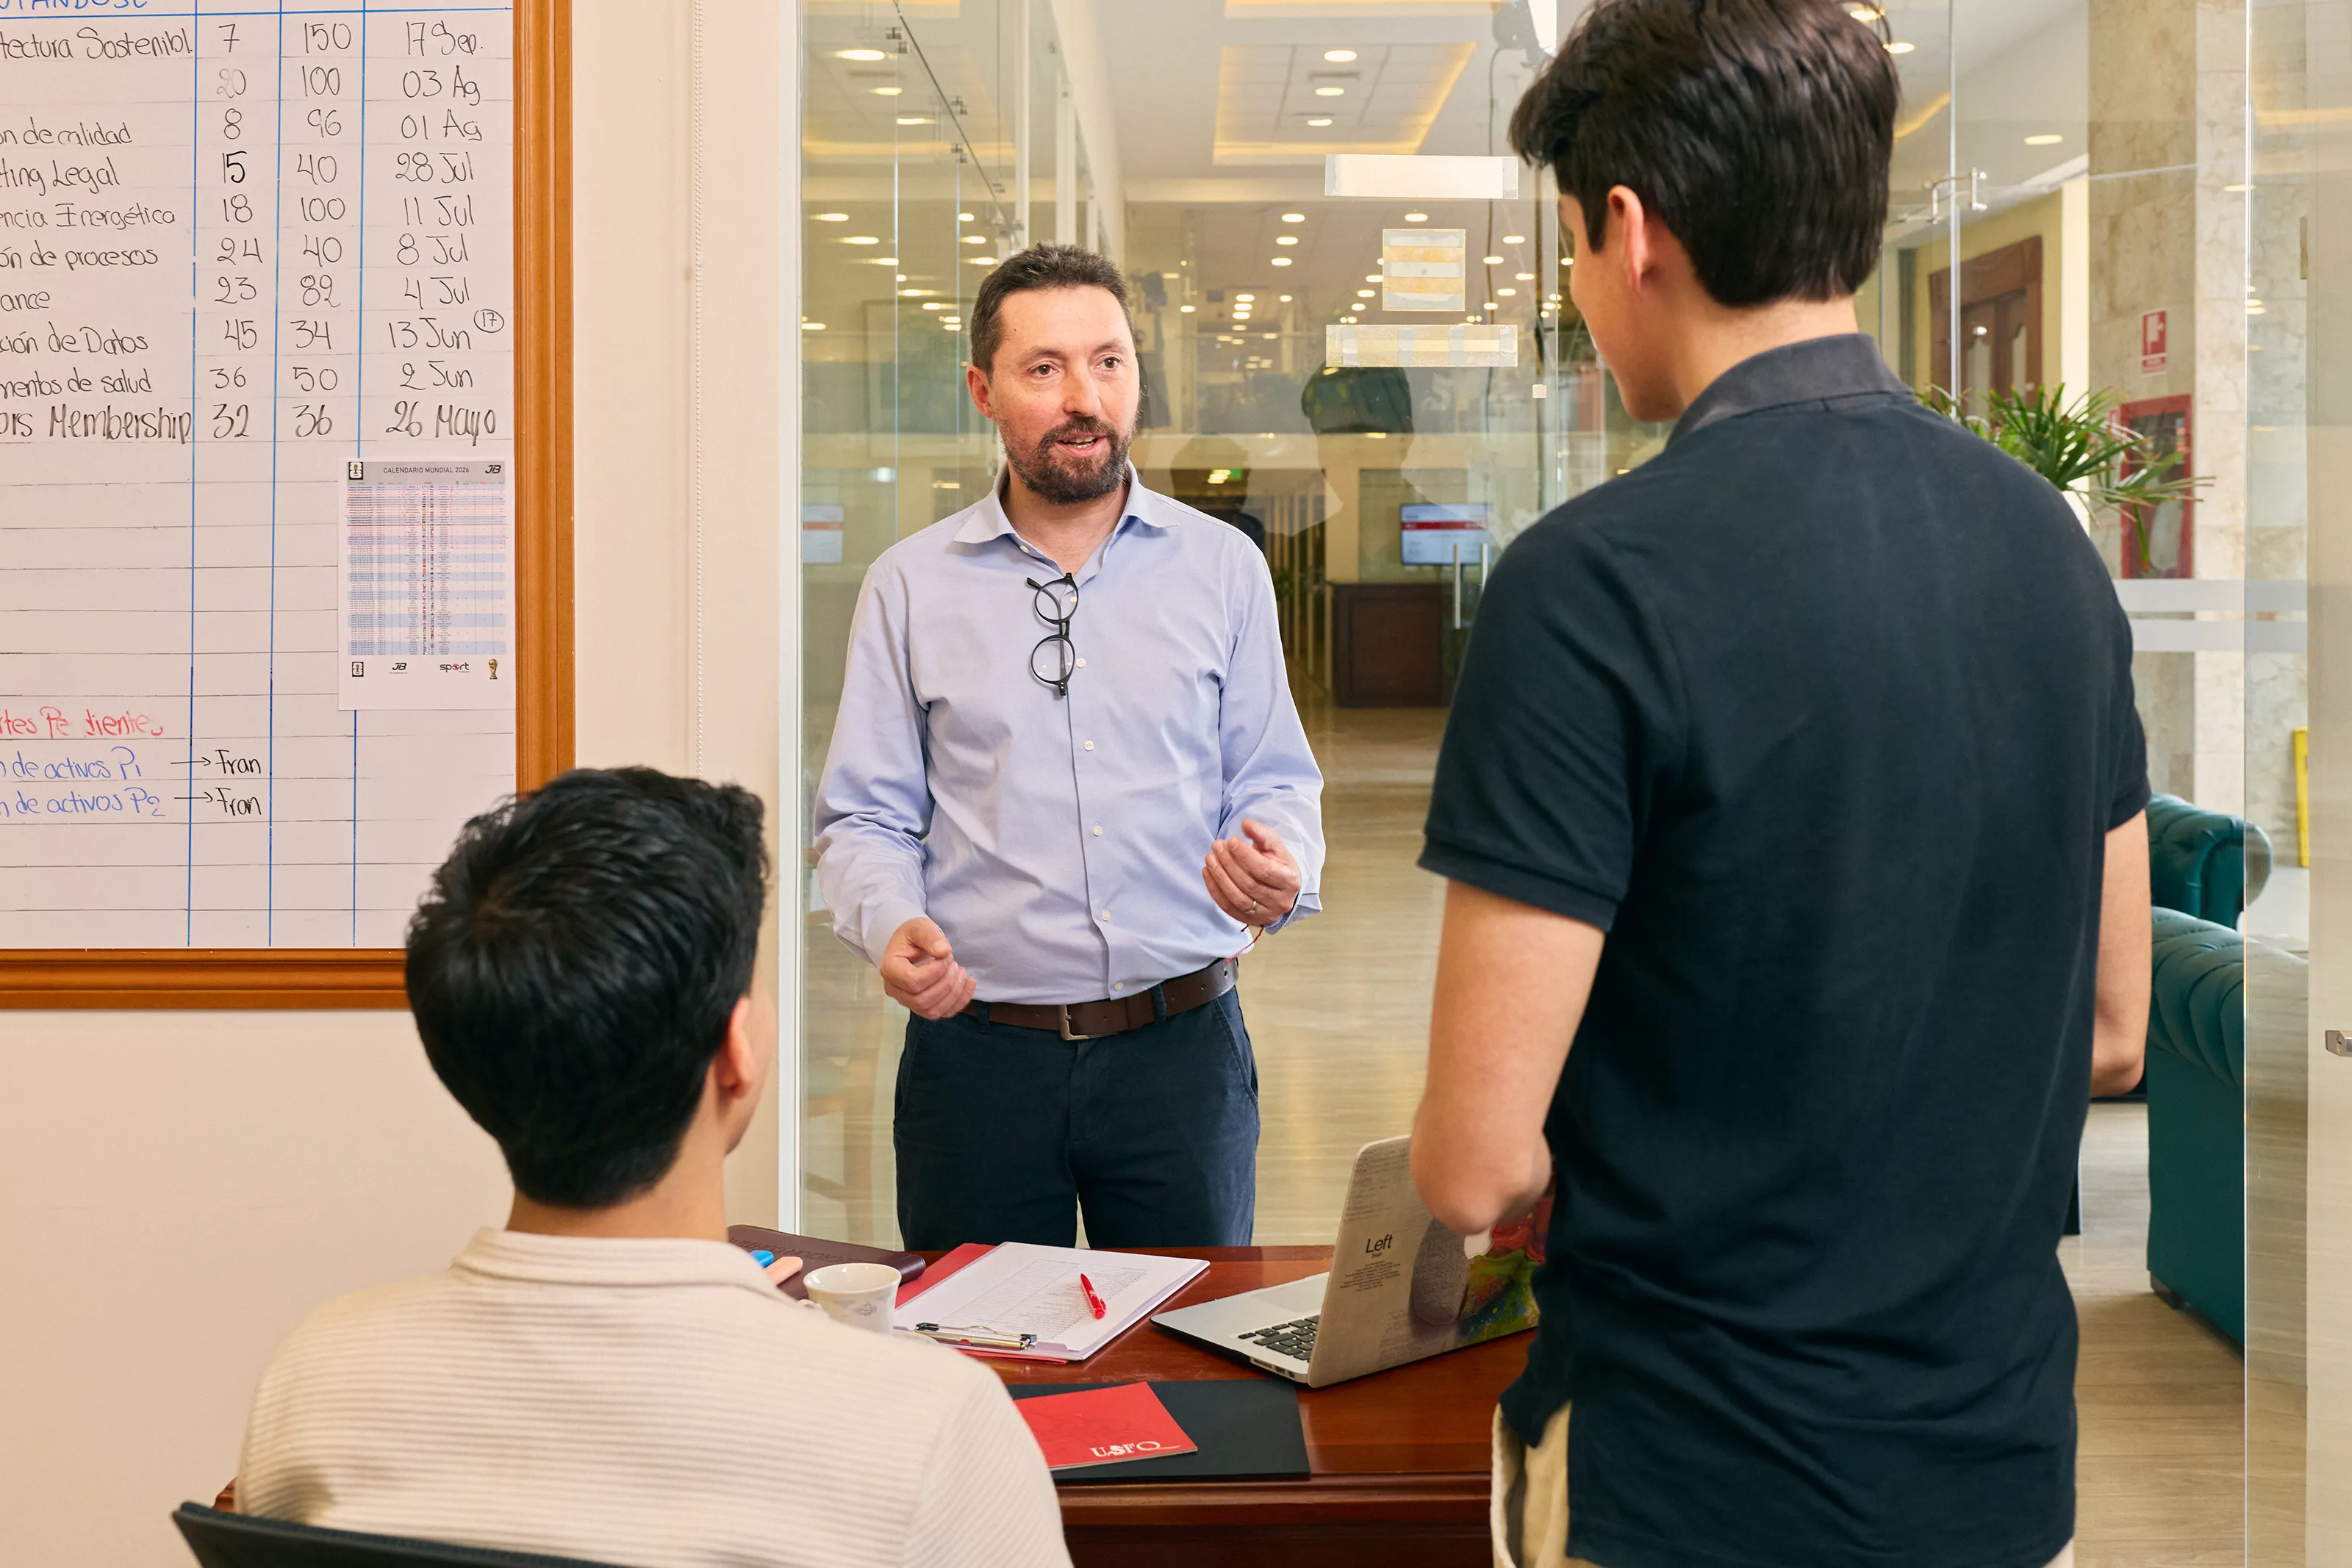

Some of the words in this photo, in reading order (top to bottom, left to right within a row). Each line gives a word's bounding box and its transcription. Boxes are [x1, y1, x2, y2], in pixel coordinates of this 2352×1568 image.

[0, 30, 74, 60] tectura
[218, 23, 240, 54] 7
[304, 22, 352, 54] 150
[406, 21, 426, 57] 17
[216, 69, 247, 99] 20
[301, 65, 340, 97] 100
[402, 70, 442, 98] 03
[452, 64, 481, 107] Ag
[23, 116, 54, 145] de
[223, 107, 243, 140] 8
[306, 108, 342, 138] 96
[401, 115, 429, 140] 01
[442, 108, 483, 142] Ag
[51, 156, 121, 195] Legal
[221, 150, 248, 184] 15
[296, 154, 337, 186] 40
[395, 151, 434, 182] 28
[438, 151, 474, 184] Jul
[223, 193, 254, 223] 18
[301, 196, 346, 223] 100
[404, 196, 423, 226] 11
[433, 194, 475, 227] Jul
[29, 239, 57, 267] de
[64, 248, 159, 271] procesos
[216, 237, 263, 266] 24
[302, 234, 343, 267] 40
[396, 232, 420, 266] 8
[425, 233, 469, 265] Jul
[0, 291, 51, 312] ance
[214, 276, 257, 305] 23
[300, 274, 341, 309] 82
[404, 276, 424, 310] 4
[433, 276, 470, 305] Jul
[223, 318, 257, 351] 45
[290, 320, 332, 350] 34
[388, 321, 418, 349] 13
[418, 317, 472, 350] Jun
[482, 312, 497, 327] 17
[48, 320, 79, 353] de
[78, 326, 148, 356] Datos
[67, 366, 93, 393] de
[100, 367, 153, 394] salud
[209, 367, 247, 389] 36
[292, 367, 338, 392] 50
[399, 362, 426, 391] 2
[427, 360, 473, 388] Jun
[49, 403, 193, 445] Membership
[212, 403, 251, 439] 32
[292, 404, 333, 438] 36
[385, 400, 423, 438] 26
[434, 406, 496, 447] Mayo
[12, 750, 39, 778] de
[43, 757, 112, 780] activos
[214, 749, 262, 775] Fran
[15, 790, 41, 815] de
[46, 791, 123, 814] activos
[214, 787, 262, 817] Fran
[1366, 1234, 1394, 1254] Left
